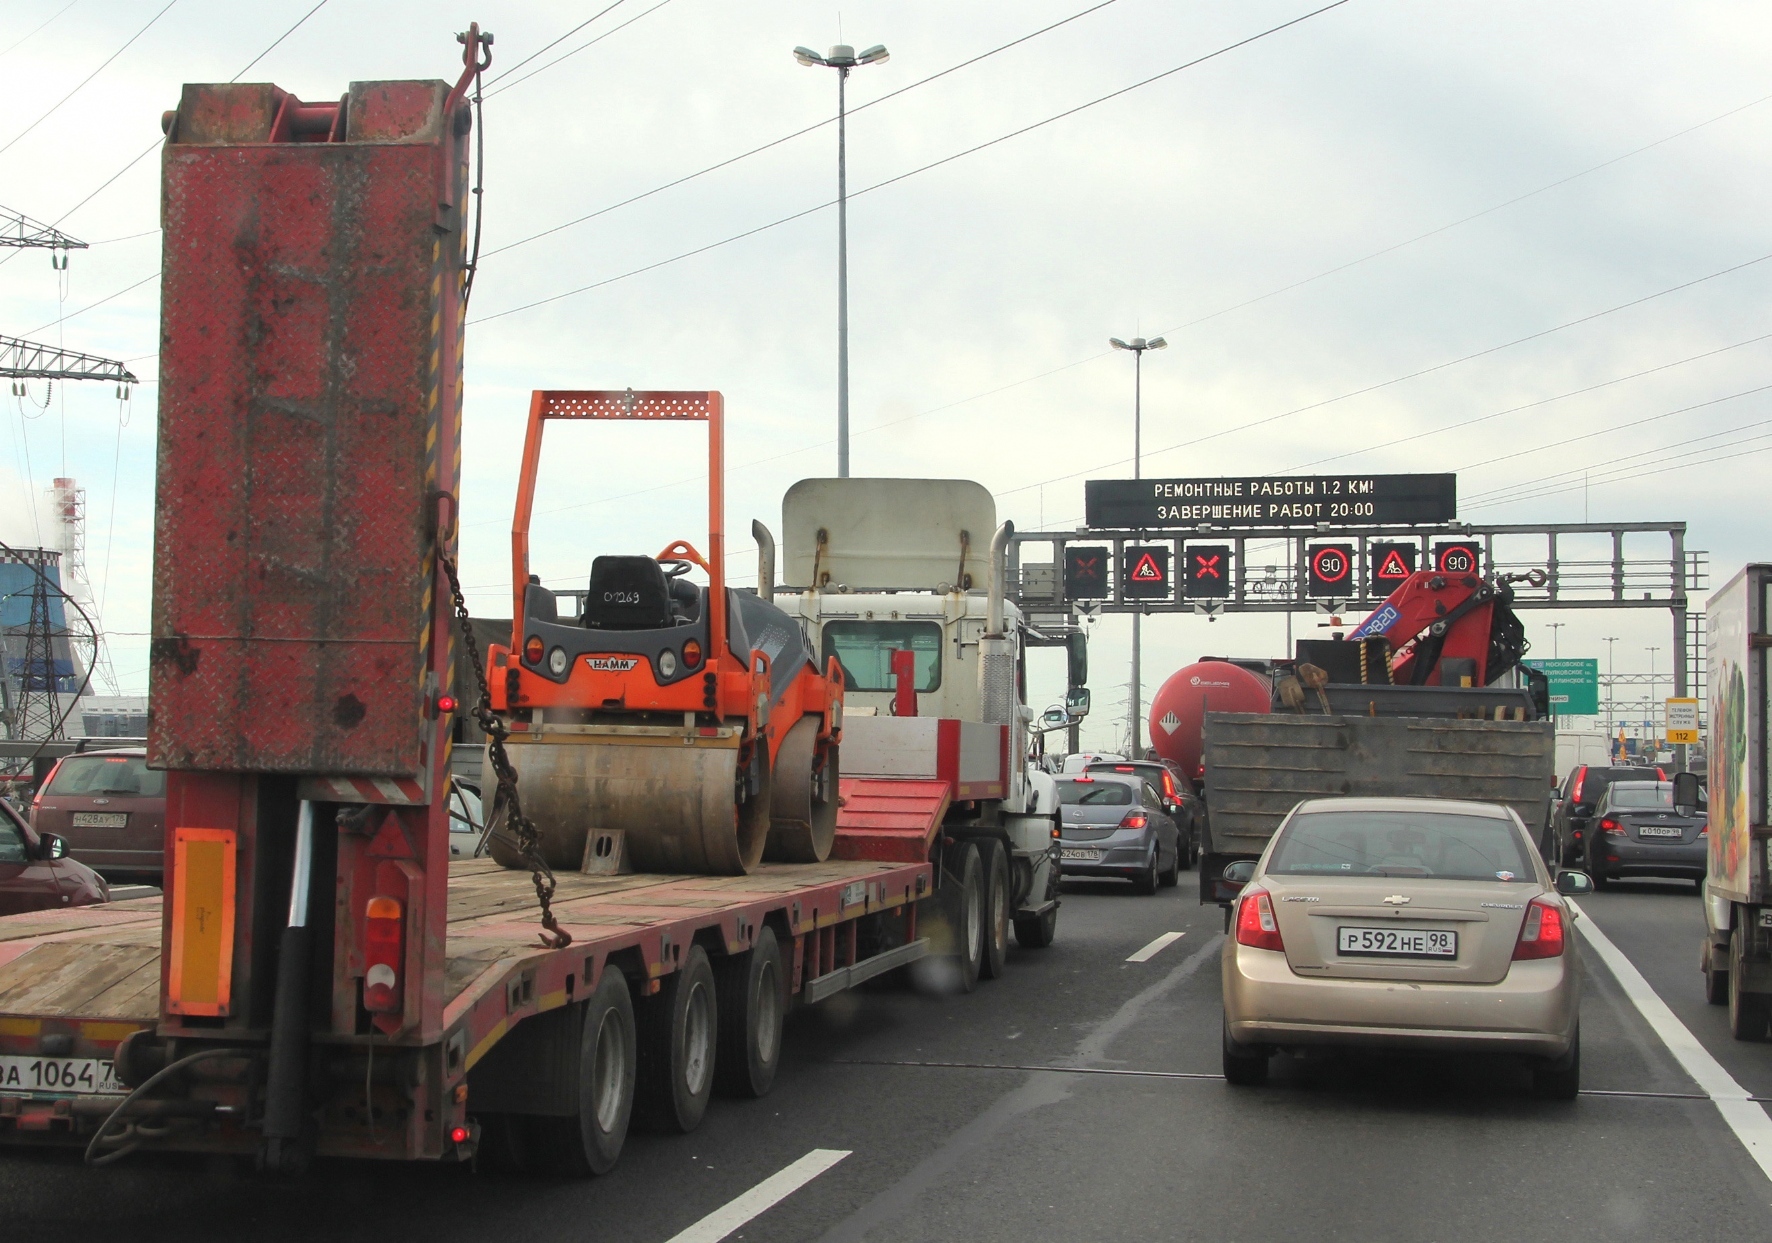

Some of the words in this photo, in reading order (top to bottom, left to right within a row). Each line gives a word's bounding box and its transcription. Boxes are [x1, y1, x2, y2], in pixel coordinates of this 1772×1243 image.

[1154, 482, 1243, 498] РЕМОНТНЫЕ
[1250, 481, 1314, 496] РАБОТЫ
[1321, 480, 1341, 495] 1.2
[1348, 480, 1374, 495] КМ!
[1157, 504, 1262, 519] ЗАВЕРШЕНИЕ
[1269, 503, 1323, 518] РАБОТ
[1330, 502, 1374, 517] 20:00
[1321, 558, 1340, 572] 90
[1448, 556, 1467, 570] 90
[594, 660, 629, 669] HAMM
[1675, 732, 1689, 741] 112
[99, 1081, 118, 1090] RUS
